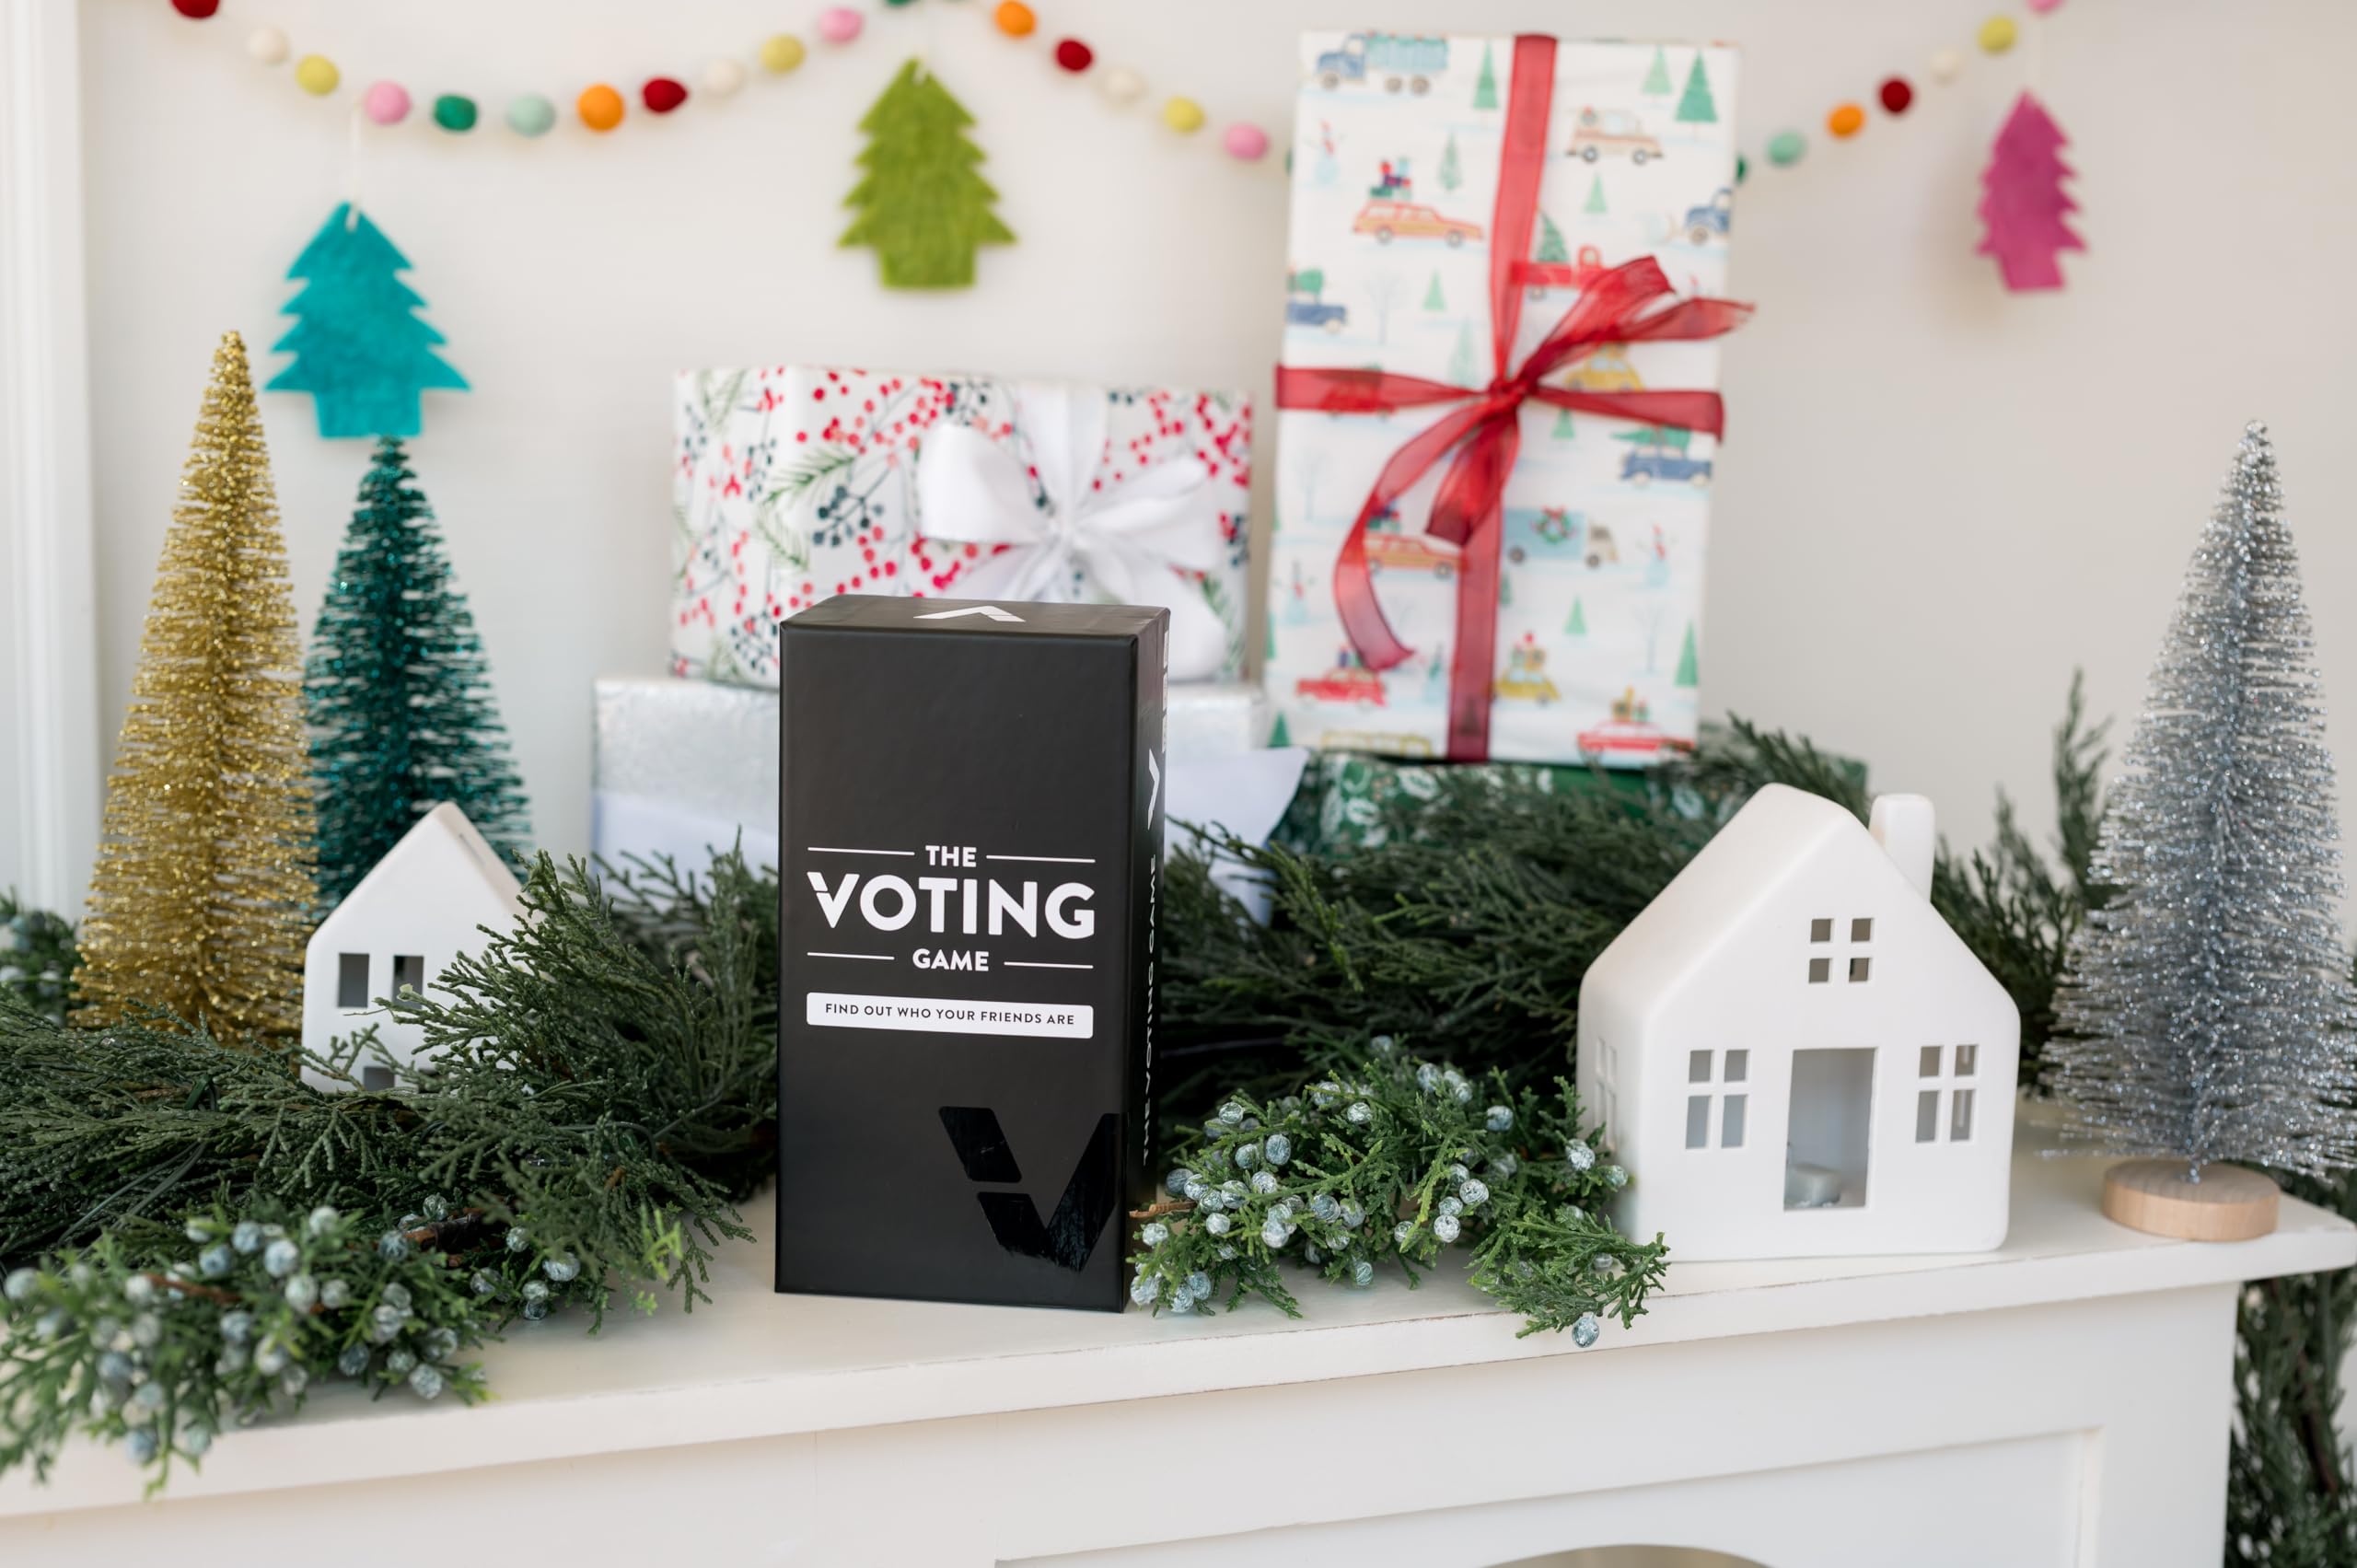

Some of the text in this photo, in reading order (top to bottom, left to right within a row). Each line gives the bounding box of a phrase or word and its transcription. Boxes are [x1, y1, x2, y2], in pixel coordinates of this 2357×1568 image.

[924, 844, 977, 868] THE
[806, 871, 1095, 939] VOTING
[911, 947, 990, 972] GAME
[825, 1003, 1075, 1026] FIND OUT WHO YOUR FRIENDS ARE
